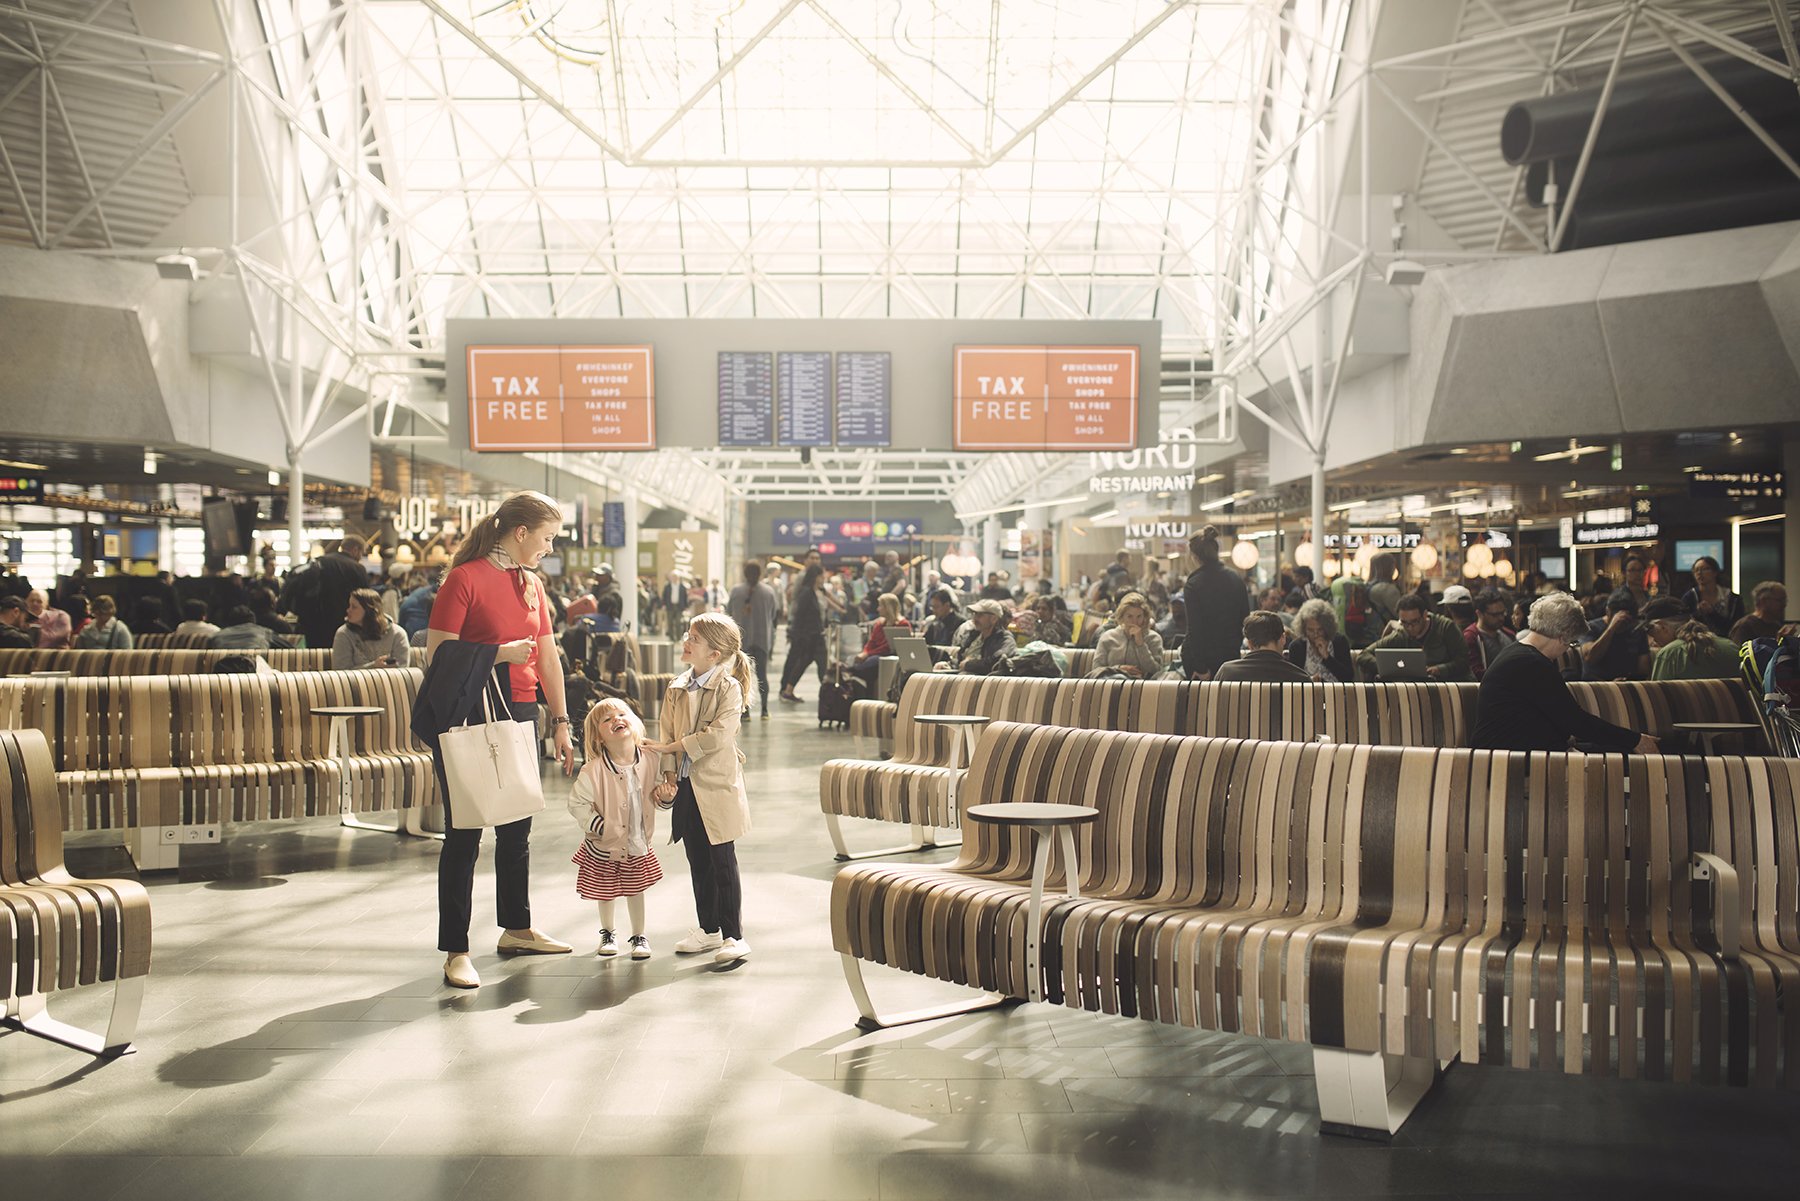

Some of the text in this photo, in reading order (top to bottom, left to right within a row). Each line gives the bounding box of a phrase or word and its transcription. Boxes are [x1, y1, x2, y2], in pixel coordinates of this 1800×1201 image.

[581, 375, 629, 384] EVERYONE
[1066, 376, 1114, 385] EVERYONE
[492, 376, 540, 396] TAX
[977, 376, 1025, 396] TAX
[591, 388, 621, 397] SHOPS
[1074, 388, 1105, 397] SHOPS
[584, 401, 628, 410] TAX FREE
[1068, 401, 1112, 410] TAX FREE
[487, 401, 548, 420] FREE
[972, 401, 1032, 420] FREE
[592, 414, 621, 422] IN ALL
[1075, 414, 1104, 422] IN ALL
[591, 426, 622, 435] SHOPS
[1074, 426, 1105, 435] SHOPS
[1089, 475, 1195, 493] RESTAURANT
[393, 497, 439, 534] JOE
